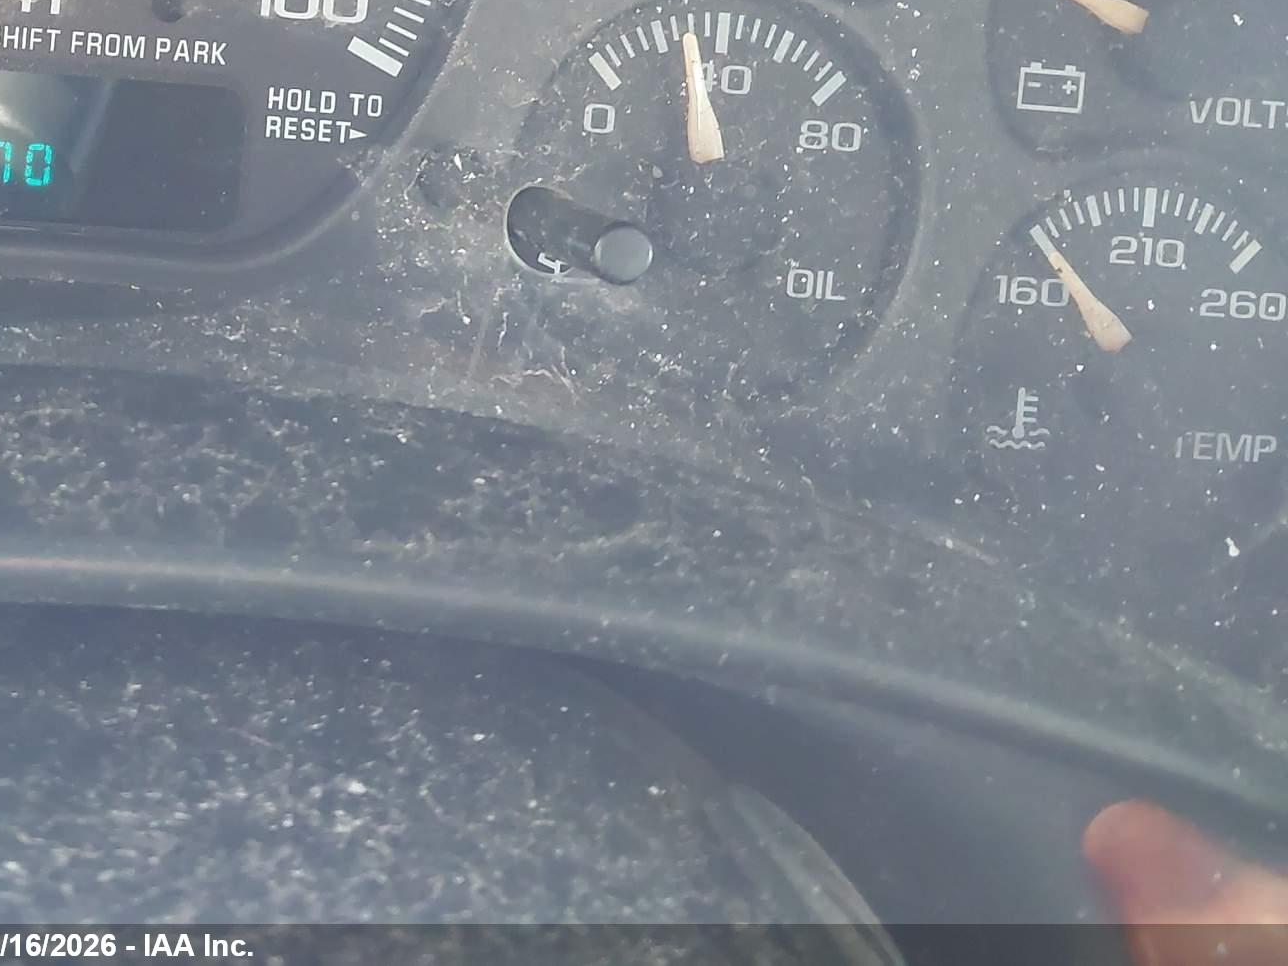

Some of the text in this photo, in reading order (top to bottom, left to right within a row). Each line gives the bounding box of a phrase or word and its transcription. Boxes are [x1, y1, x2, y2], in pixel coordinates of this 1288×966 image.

[70, 31, 145, 58] FROM
[155, 38, 228, 65] PARK
[267, 86, 382, 117] HOLD TO
[1189, 97, 1288, 129] VOLT
[265, 115, 352, 142] RESET
[583, 103, 615, 134] 0
[799, 119, 862, 152] 80
[1109, 235, 1185, 268] 210
[786, 268, 846, 301] OIL
[993, 275, 1070, 307] 160
[1199, 288, 1287, 321] 260
